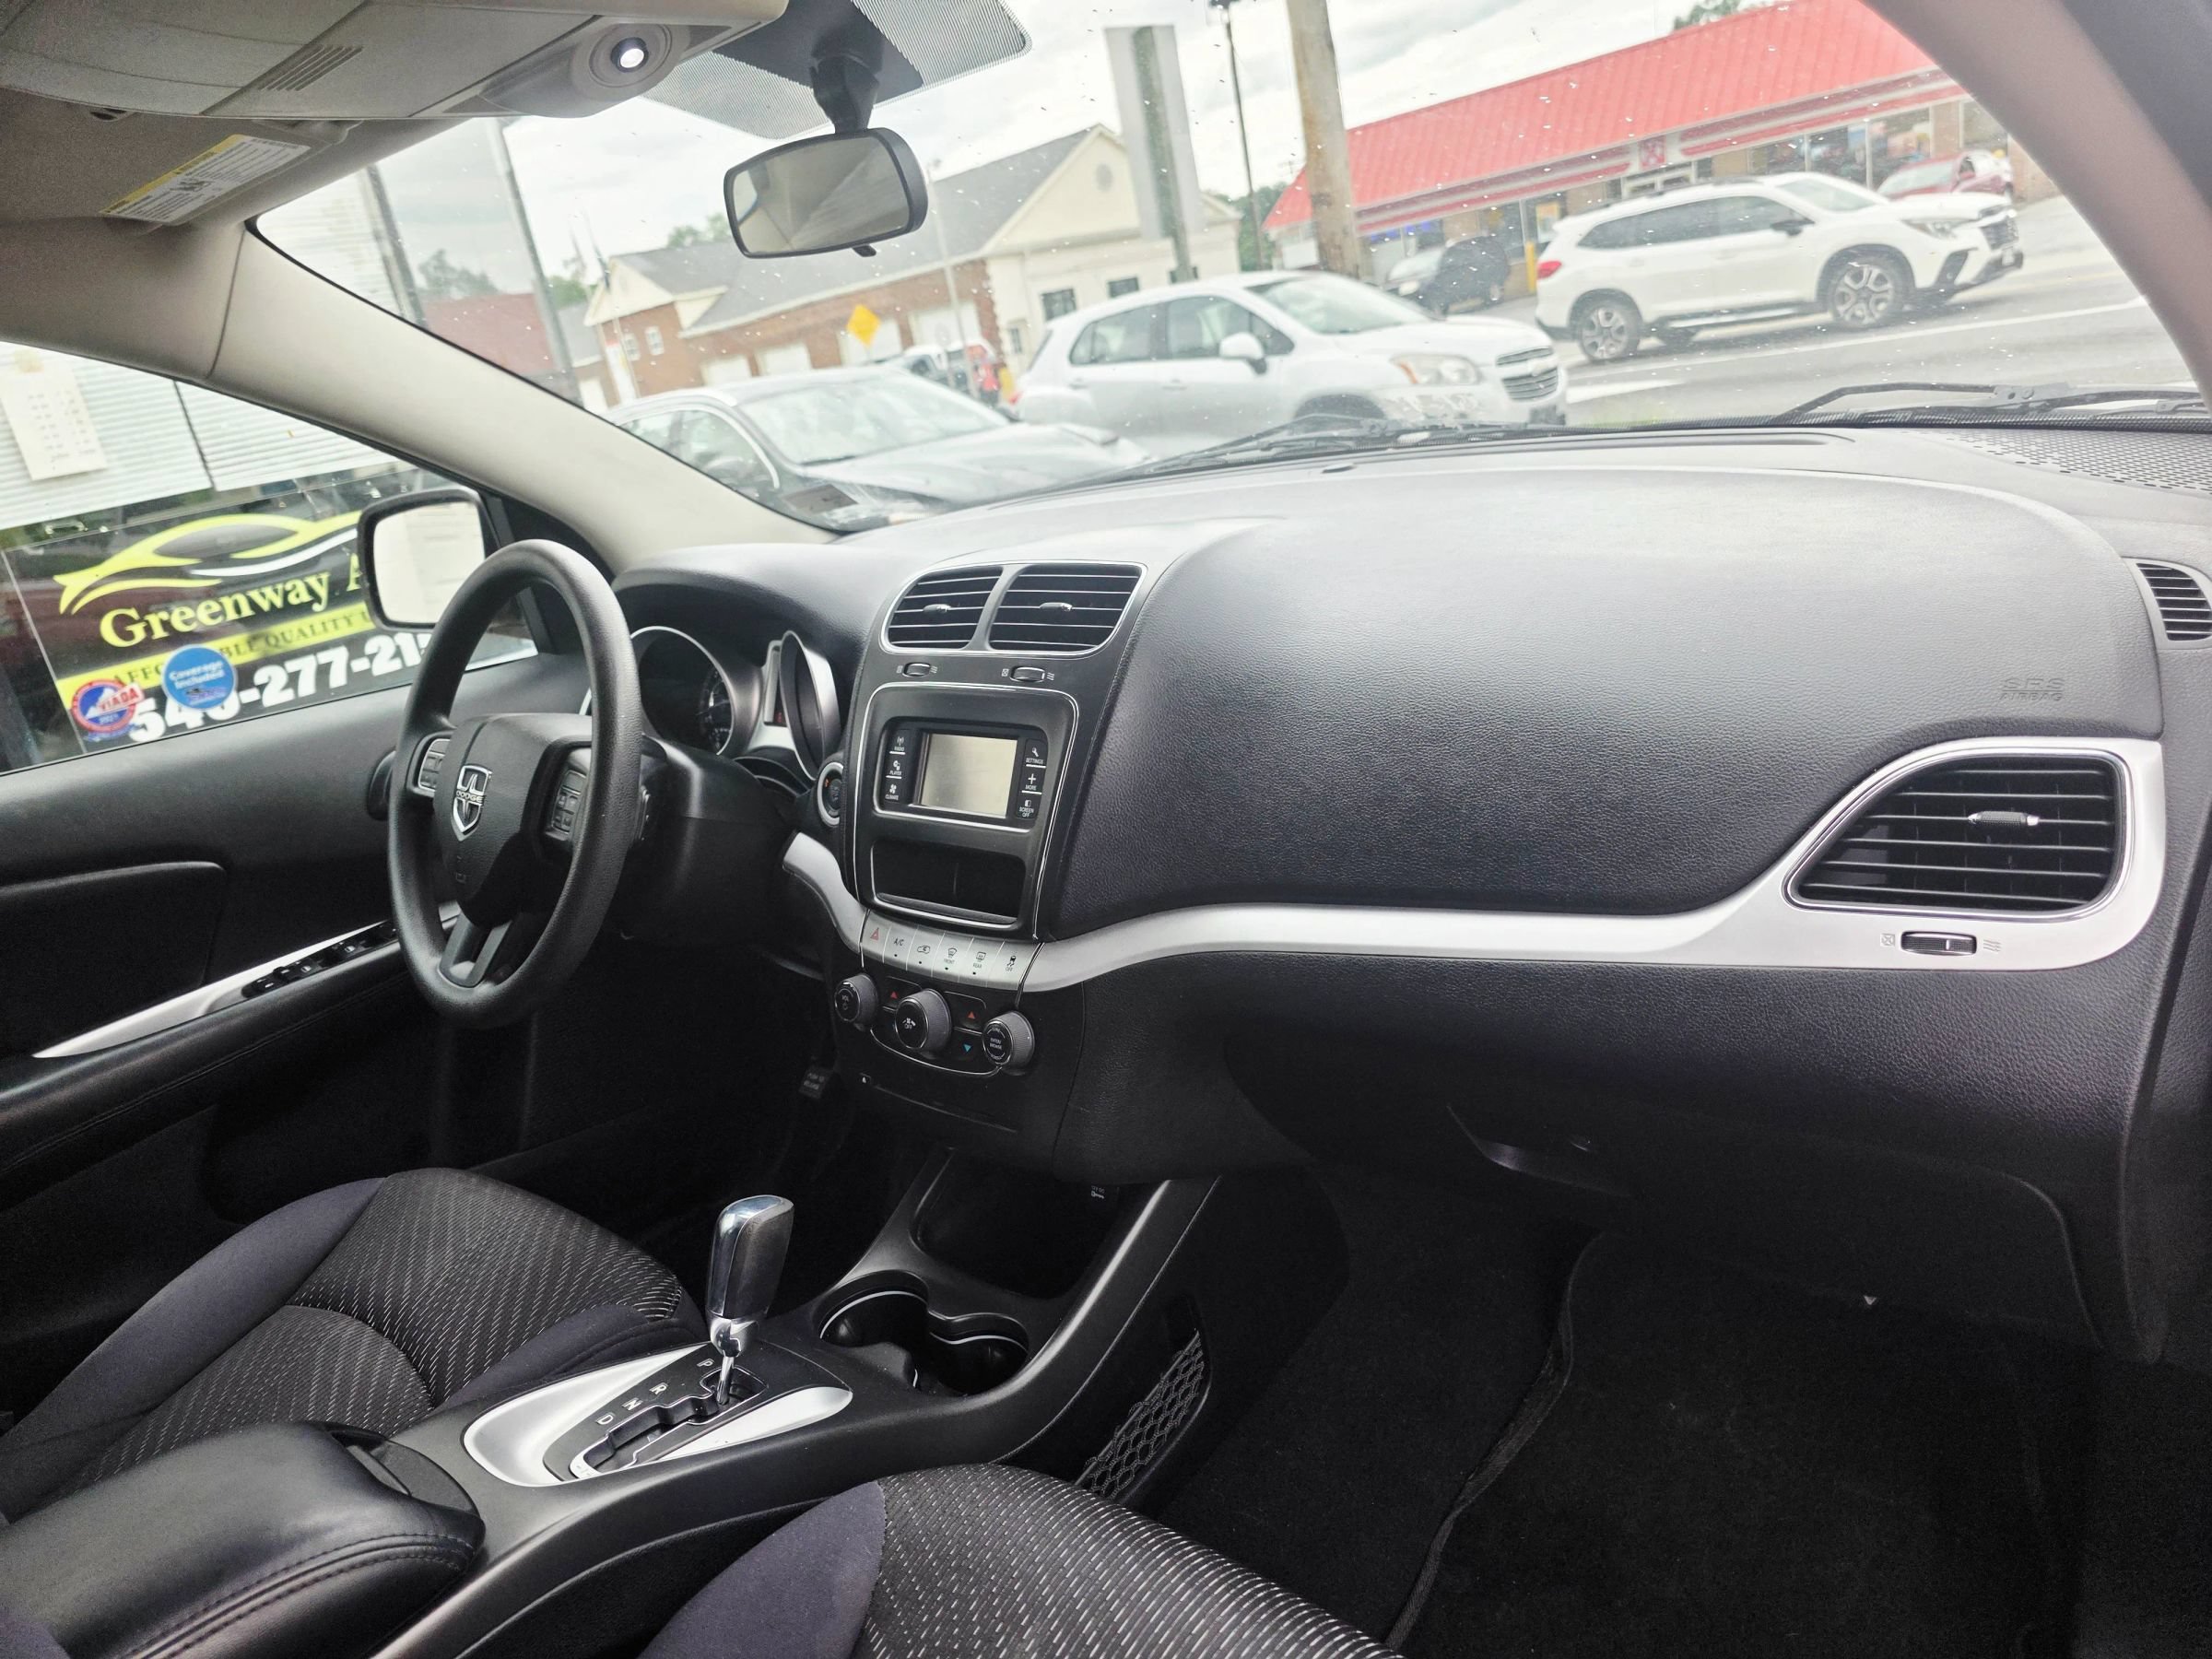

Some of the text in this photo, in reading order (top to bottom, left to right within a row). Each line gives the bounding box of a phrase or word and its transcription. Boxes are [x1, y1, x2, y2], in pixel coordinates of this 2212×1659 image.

[100, 571, 330, 648] Greenway
[265, 616, 355, 648] QUALITY
[2004, 677, 2065, 689] SRS
[1999, 692, 2064, 701] AIRBAG
[456, 791, 484, 804] DODGE
[893, 937, 905, 947] A/C
[697, 1359, 714, 1368] P
[651, 1382, 668, 1394] R
[623, 1397, 642, 1410] N
[596, 1413, 615, 1425] D
